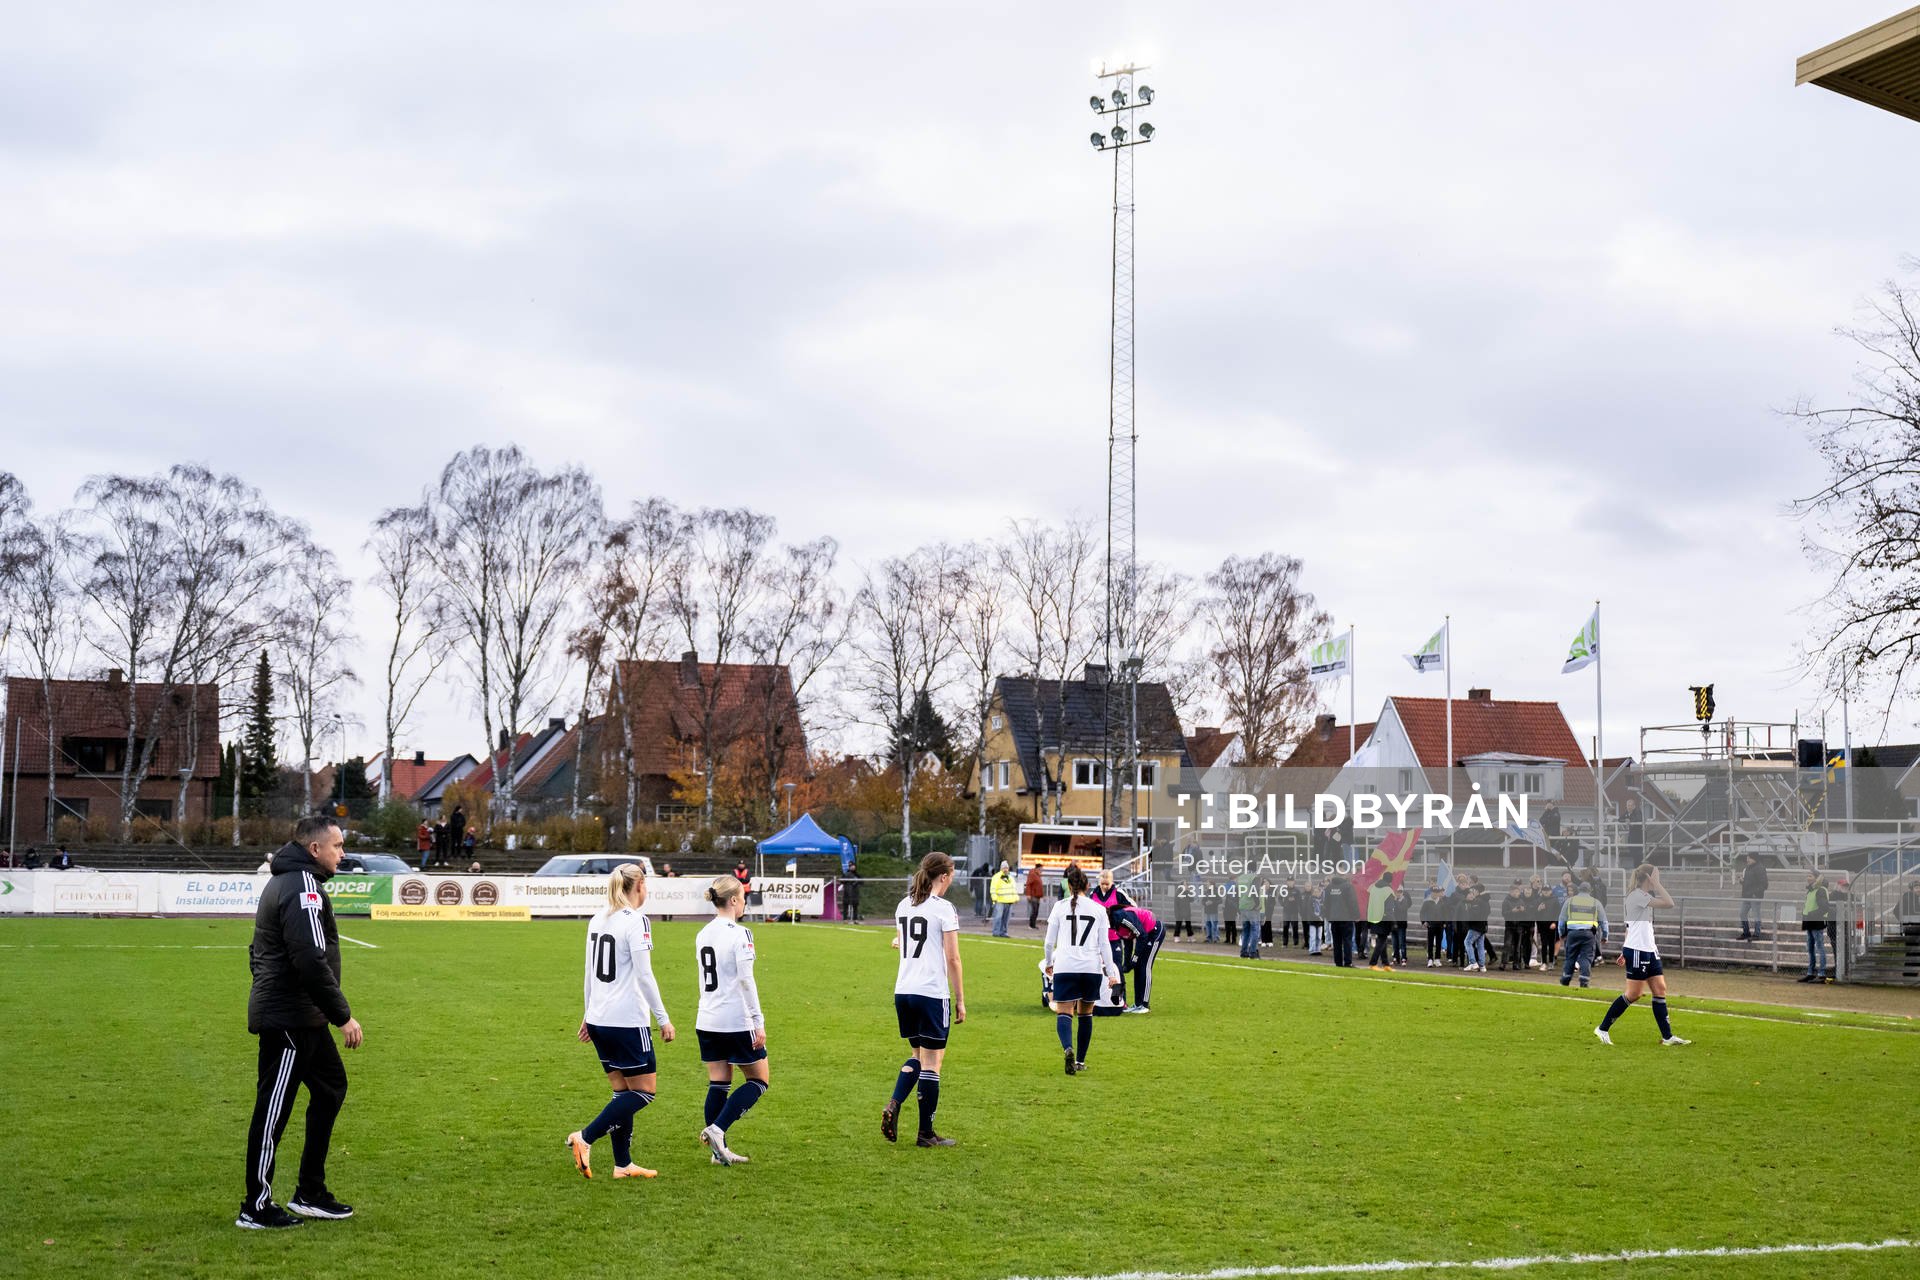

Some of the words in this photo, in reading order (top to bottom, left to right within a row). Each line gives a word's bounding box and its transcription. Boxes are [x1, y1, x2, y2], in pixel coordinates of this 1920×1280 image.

[186, 881, 203, 892] EL
[219, 881, 253, 892] DATA
[525, 885, 570, 897] Trelleborgs
[571, 885, 608, 896] Allehanda
[760, 883, 820, 894] LARSSON
[176, 896, 244, 906] Installatoren
[655, 891, 684, 900] CLASS
[1066, 915, 1096, 947] 17
[899, 916, 928, 959] 19
[591, 932, 616, 983] 10
[700, 946, 719, 992] 8
